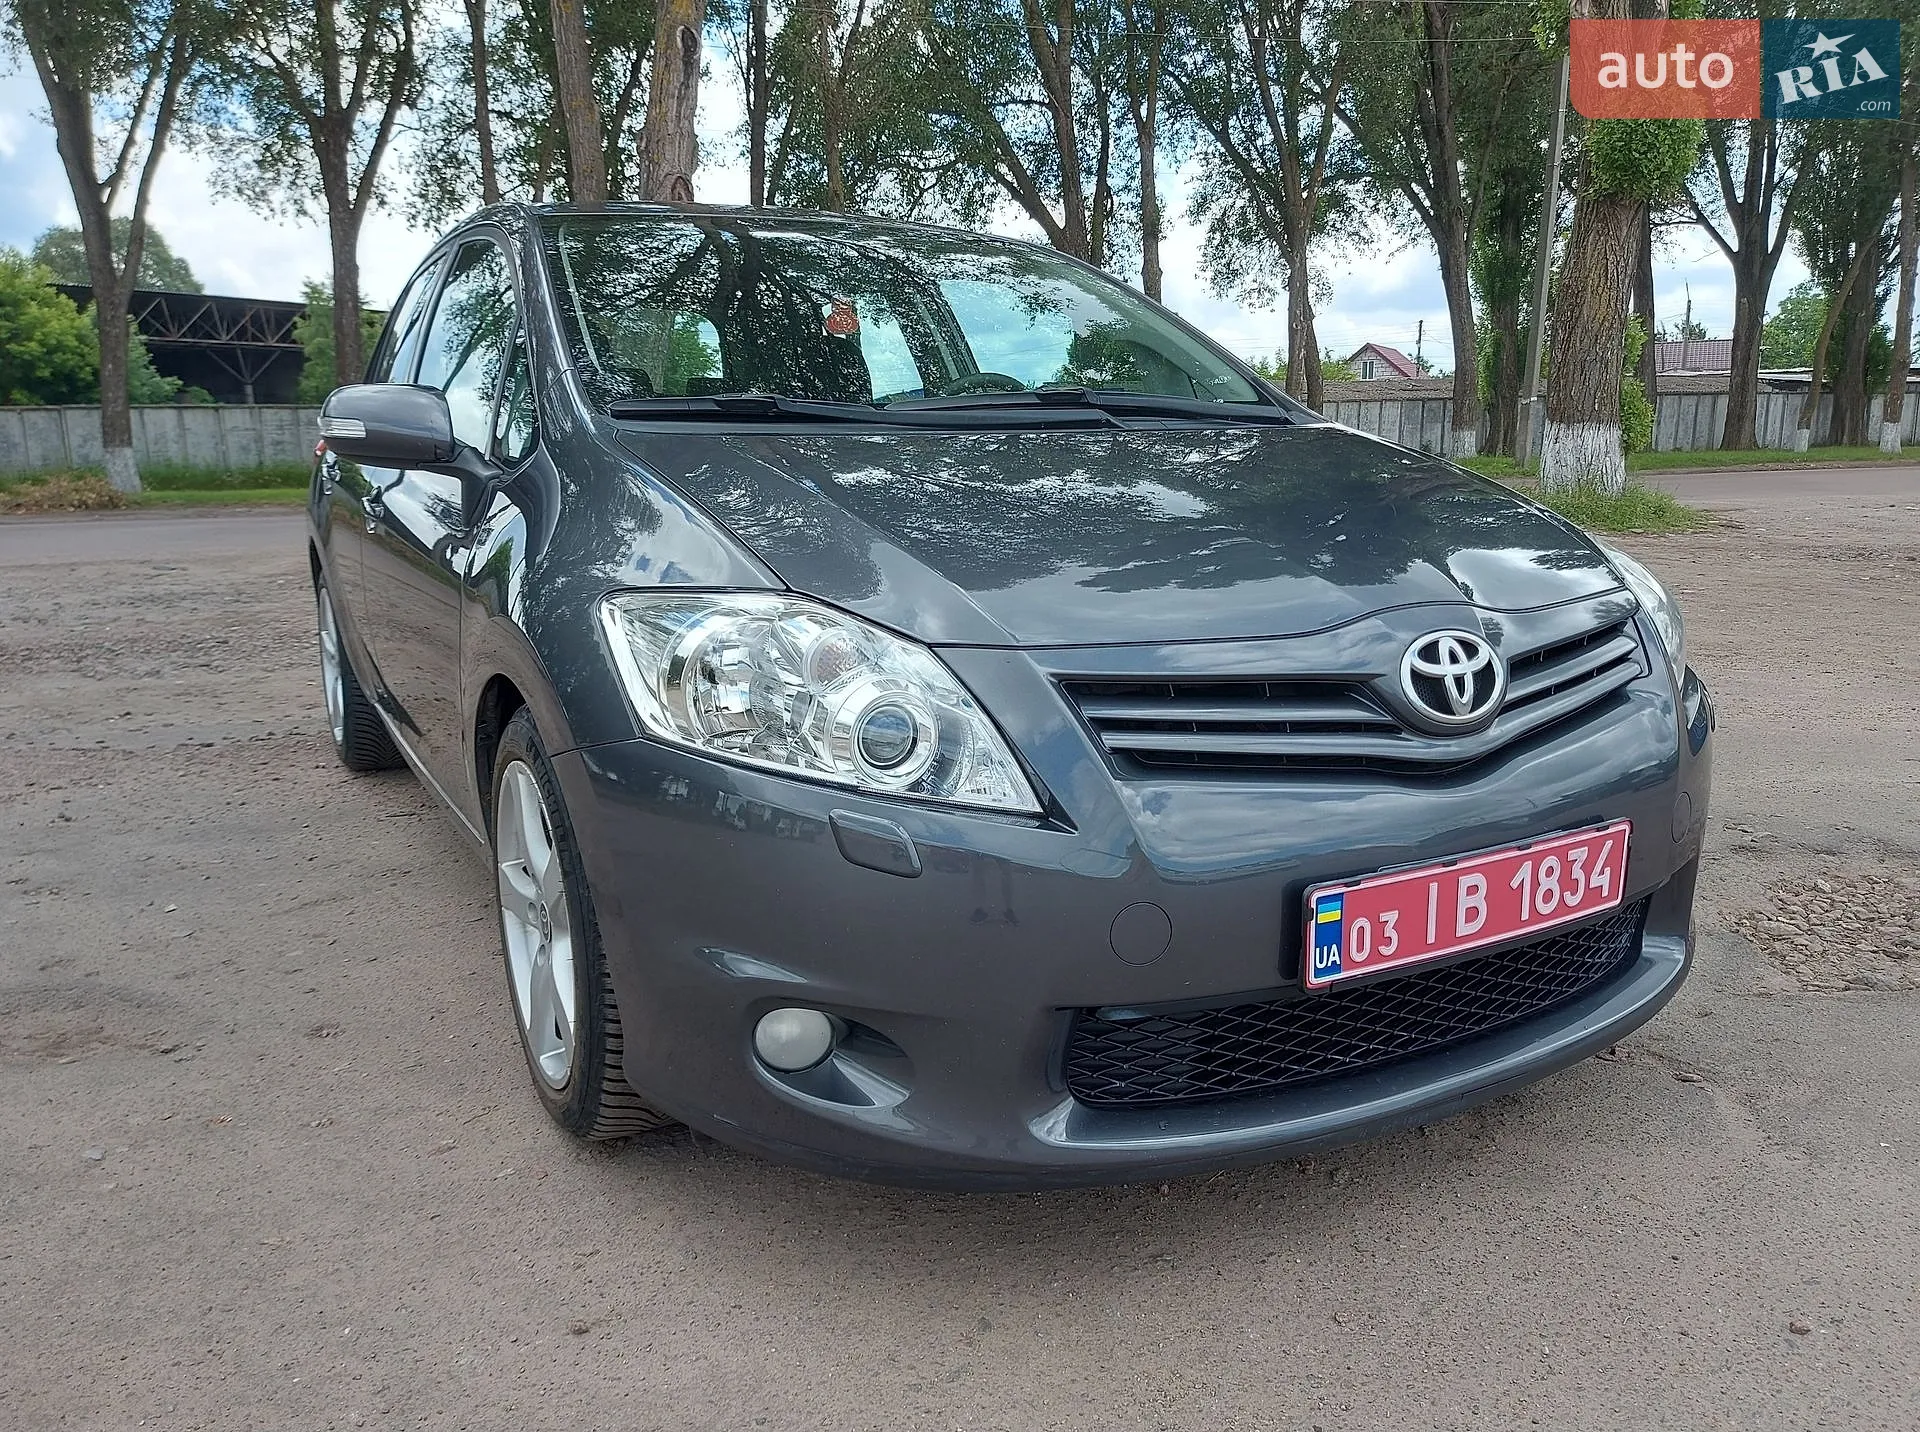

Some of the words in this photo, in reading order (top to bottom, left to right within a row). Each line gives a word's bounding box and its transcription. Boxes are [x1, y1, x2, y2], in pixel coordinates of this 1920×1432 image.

[1349, 910, 1400, 963] 03
[1510, 839, 1614, 922] 1834
[1315, 943, 1342, 969] UA
